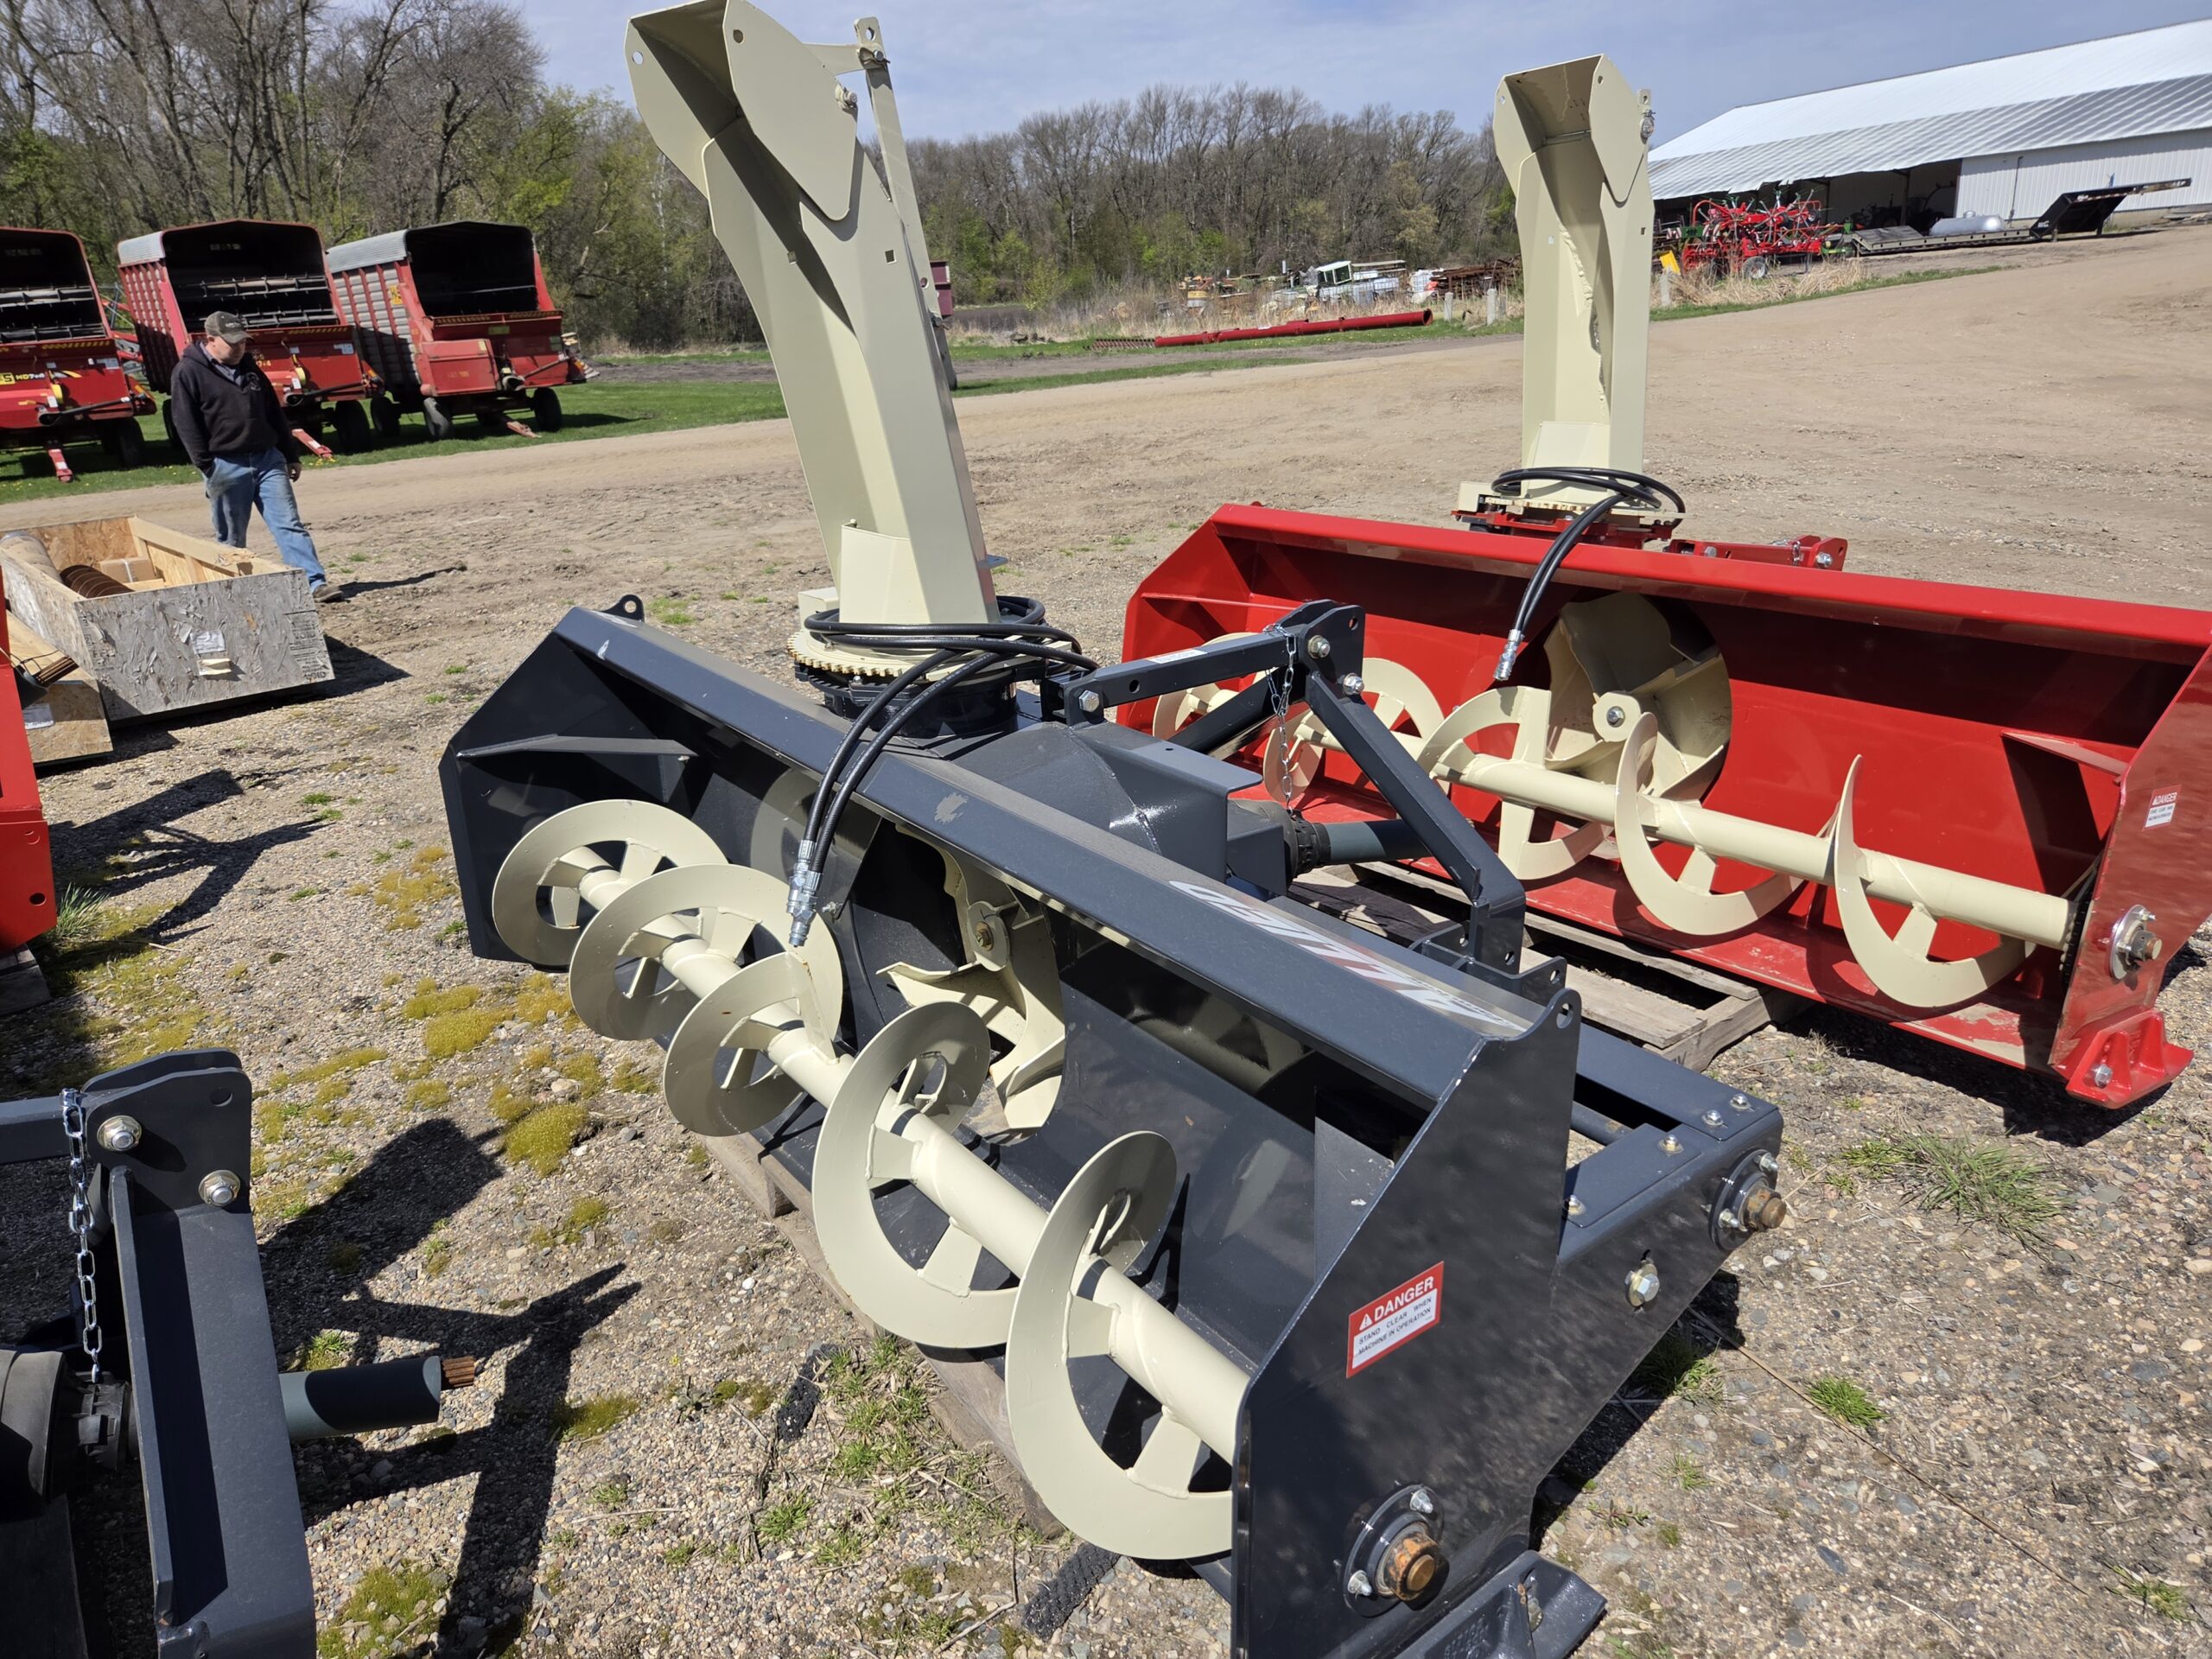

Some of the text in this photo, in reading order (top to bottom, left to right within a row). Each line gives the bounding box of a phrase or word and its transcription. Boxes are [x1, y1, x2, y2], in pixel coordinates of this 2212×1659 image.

[1168, 880, 1510, 1027] ALLIED
[1359, 1297, 1432, 1344] STAND CLEAR WHEN
[1374, 1276, 1434, 1322] DANGER
[1358, 1307, 1431, 1355] MACHINE IN OPERATION
